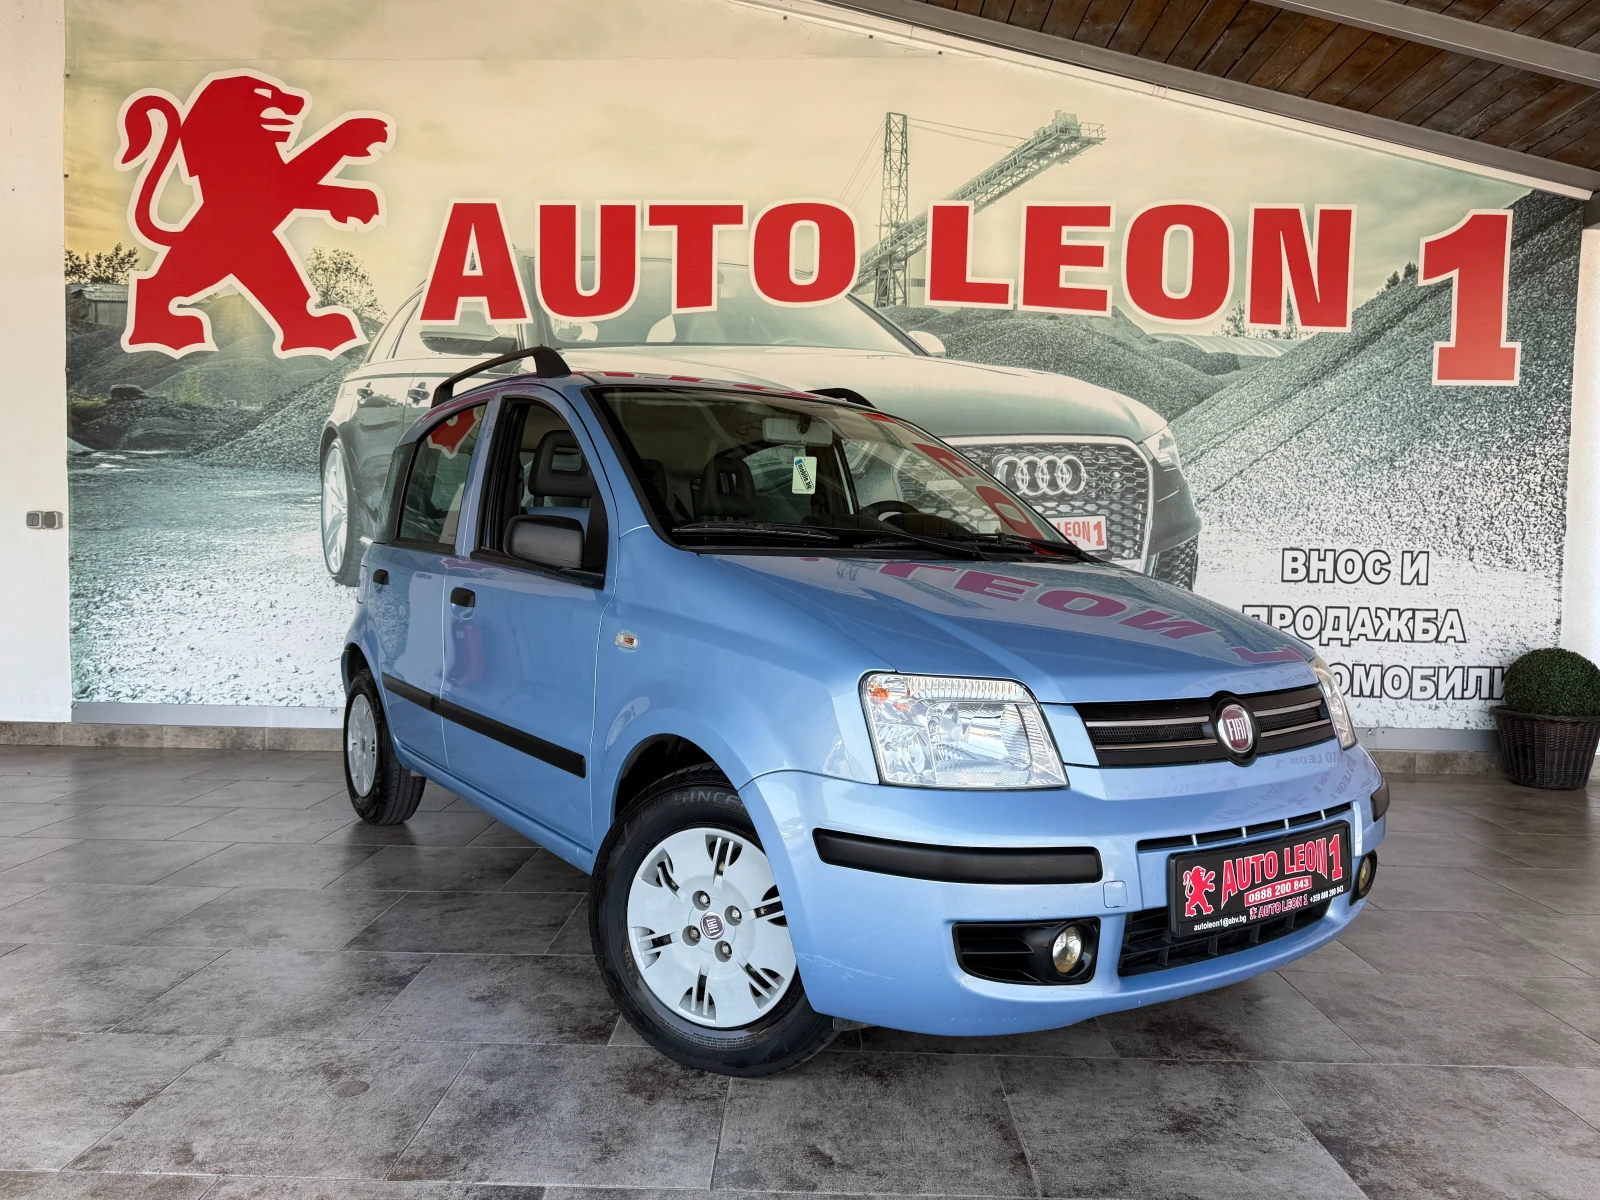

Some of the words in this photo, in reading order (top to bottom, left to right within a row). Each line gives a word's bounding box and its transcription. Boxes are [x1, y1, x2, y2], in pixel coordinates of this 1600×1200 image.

[418, 199, 859, 323] AUTO
[926, 200, 1357, 332] LEON
[1418, 209, 1521, 385] 1
[1093, 520, 1104, 546] 1
[1281, 548, 1391, 584] ВНОС
[1400, 551, 1430, 585] И
[1226, 718, 1247, 741] FIAT
[1221, 851, 1278, 910] AUTO
[1284, 837, 1328, 879] LEON
[1329, 833, 1343, 881] 1
[1248, 887, 1273, 903] 0888
[1275, 882, 1291, 895] 200
[1294, 878, 1309, 890] 843
[1258, 902, 1282, 919] AUTO
[1281, 895, 1303, 913] LEON
[705, 918, 720, 934] FIAT
[1193, 915, 1247, 931] autoleon1@abv.bg
